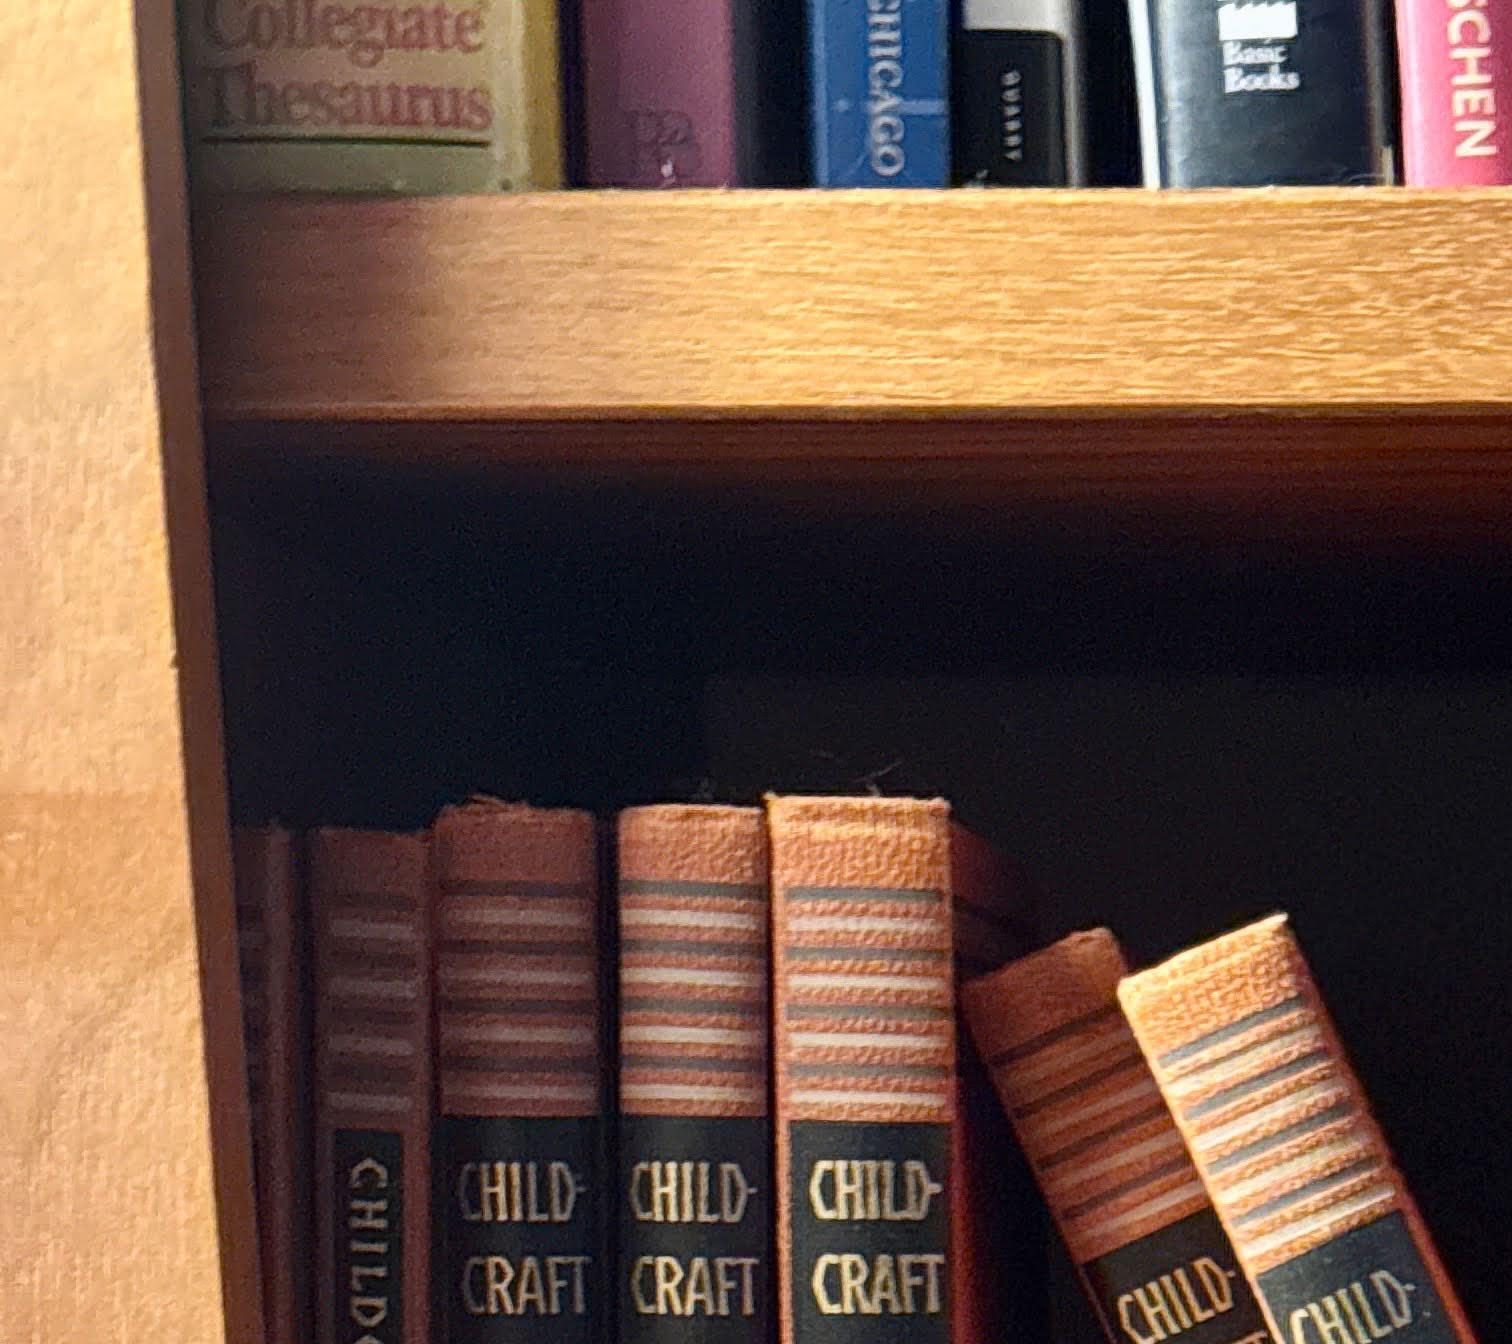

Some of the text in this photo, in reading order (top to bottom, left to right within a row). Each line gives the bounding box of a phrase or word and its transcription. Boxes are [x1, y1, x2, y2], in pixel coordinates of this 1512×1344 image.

[203, 0, 485, 68] Collegiate
[203, 62, 493, 130] Thesaurus
[1447, 0, 1498, 157] CHEN
[462, 1256, 592, 1316] CRAFT
[632, 1256, 761, 1317] CRAFT
[811, 1253, 946, 1316] CRAFT
